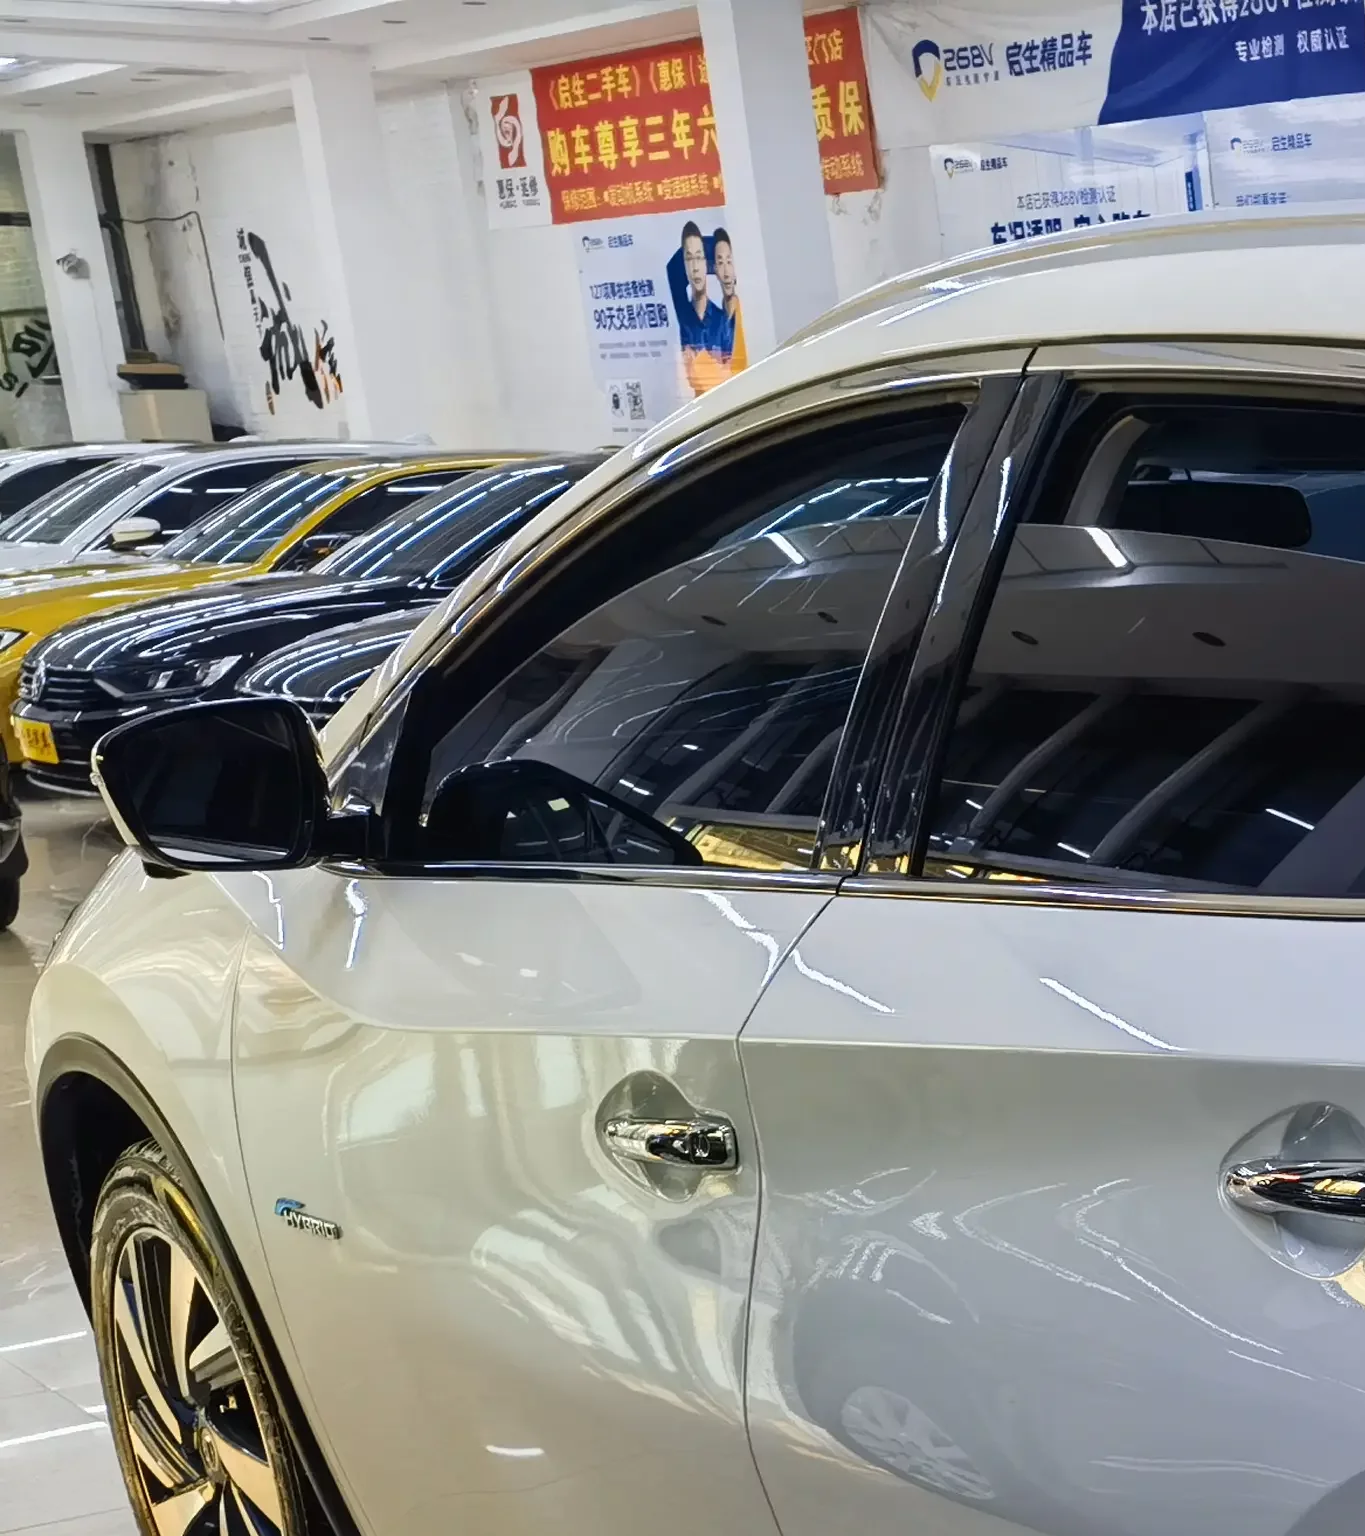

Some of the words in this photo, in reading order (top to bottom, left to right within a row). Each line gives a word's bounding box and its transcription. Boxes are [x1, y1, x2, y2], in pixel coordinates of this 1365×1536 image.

[1005, 29, 1093, 77] 启生精品车
[1235, 33, 1285, 62] 专业检测
[1297, 25, 1350, 54] 权威认证
[283, 1208, 342, 1240] HYBRID
